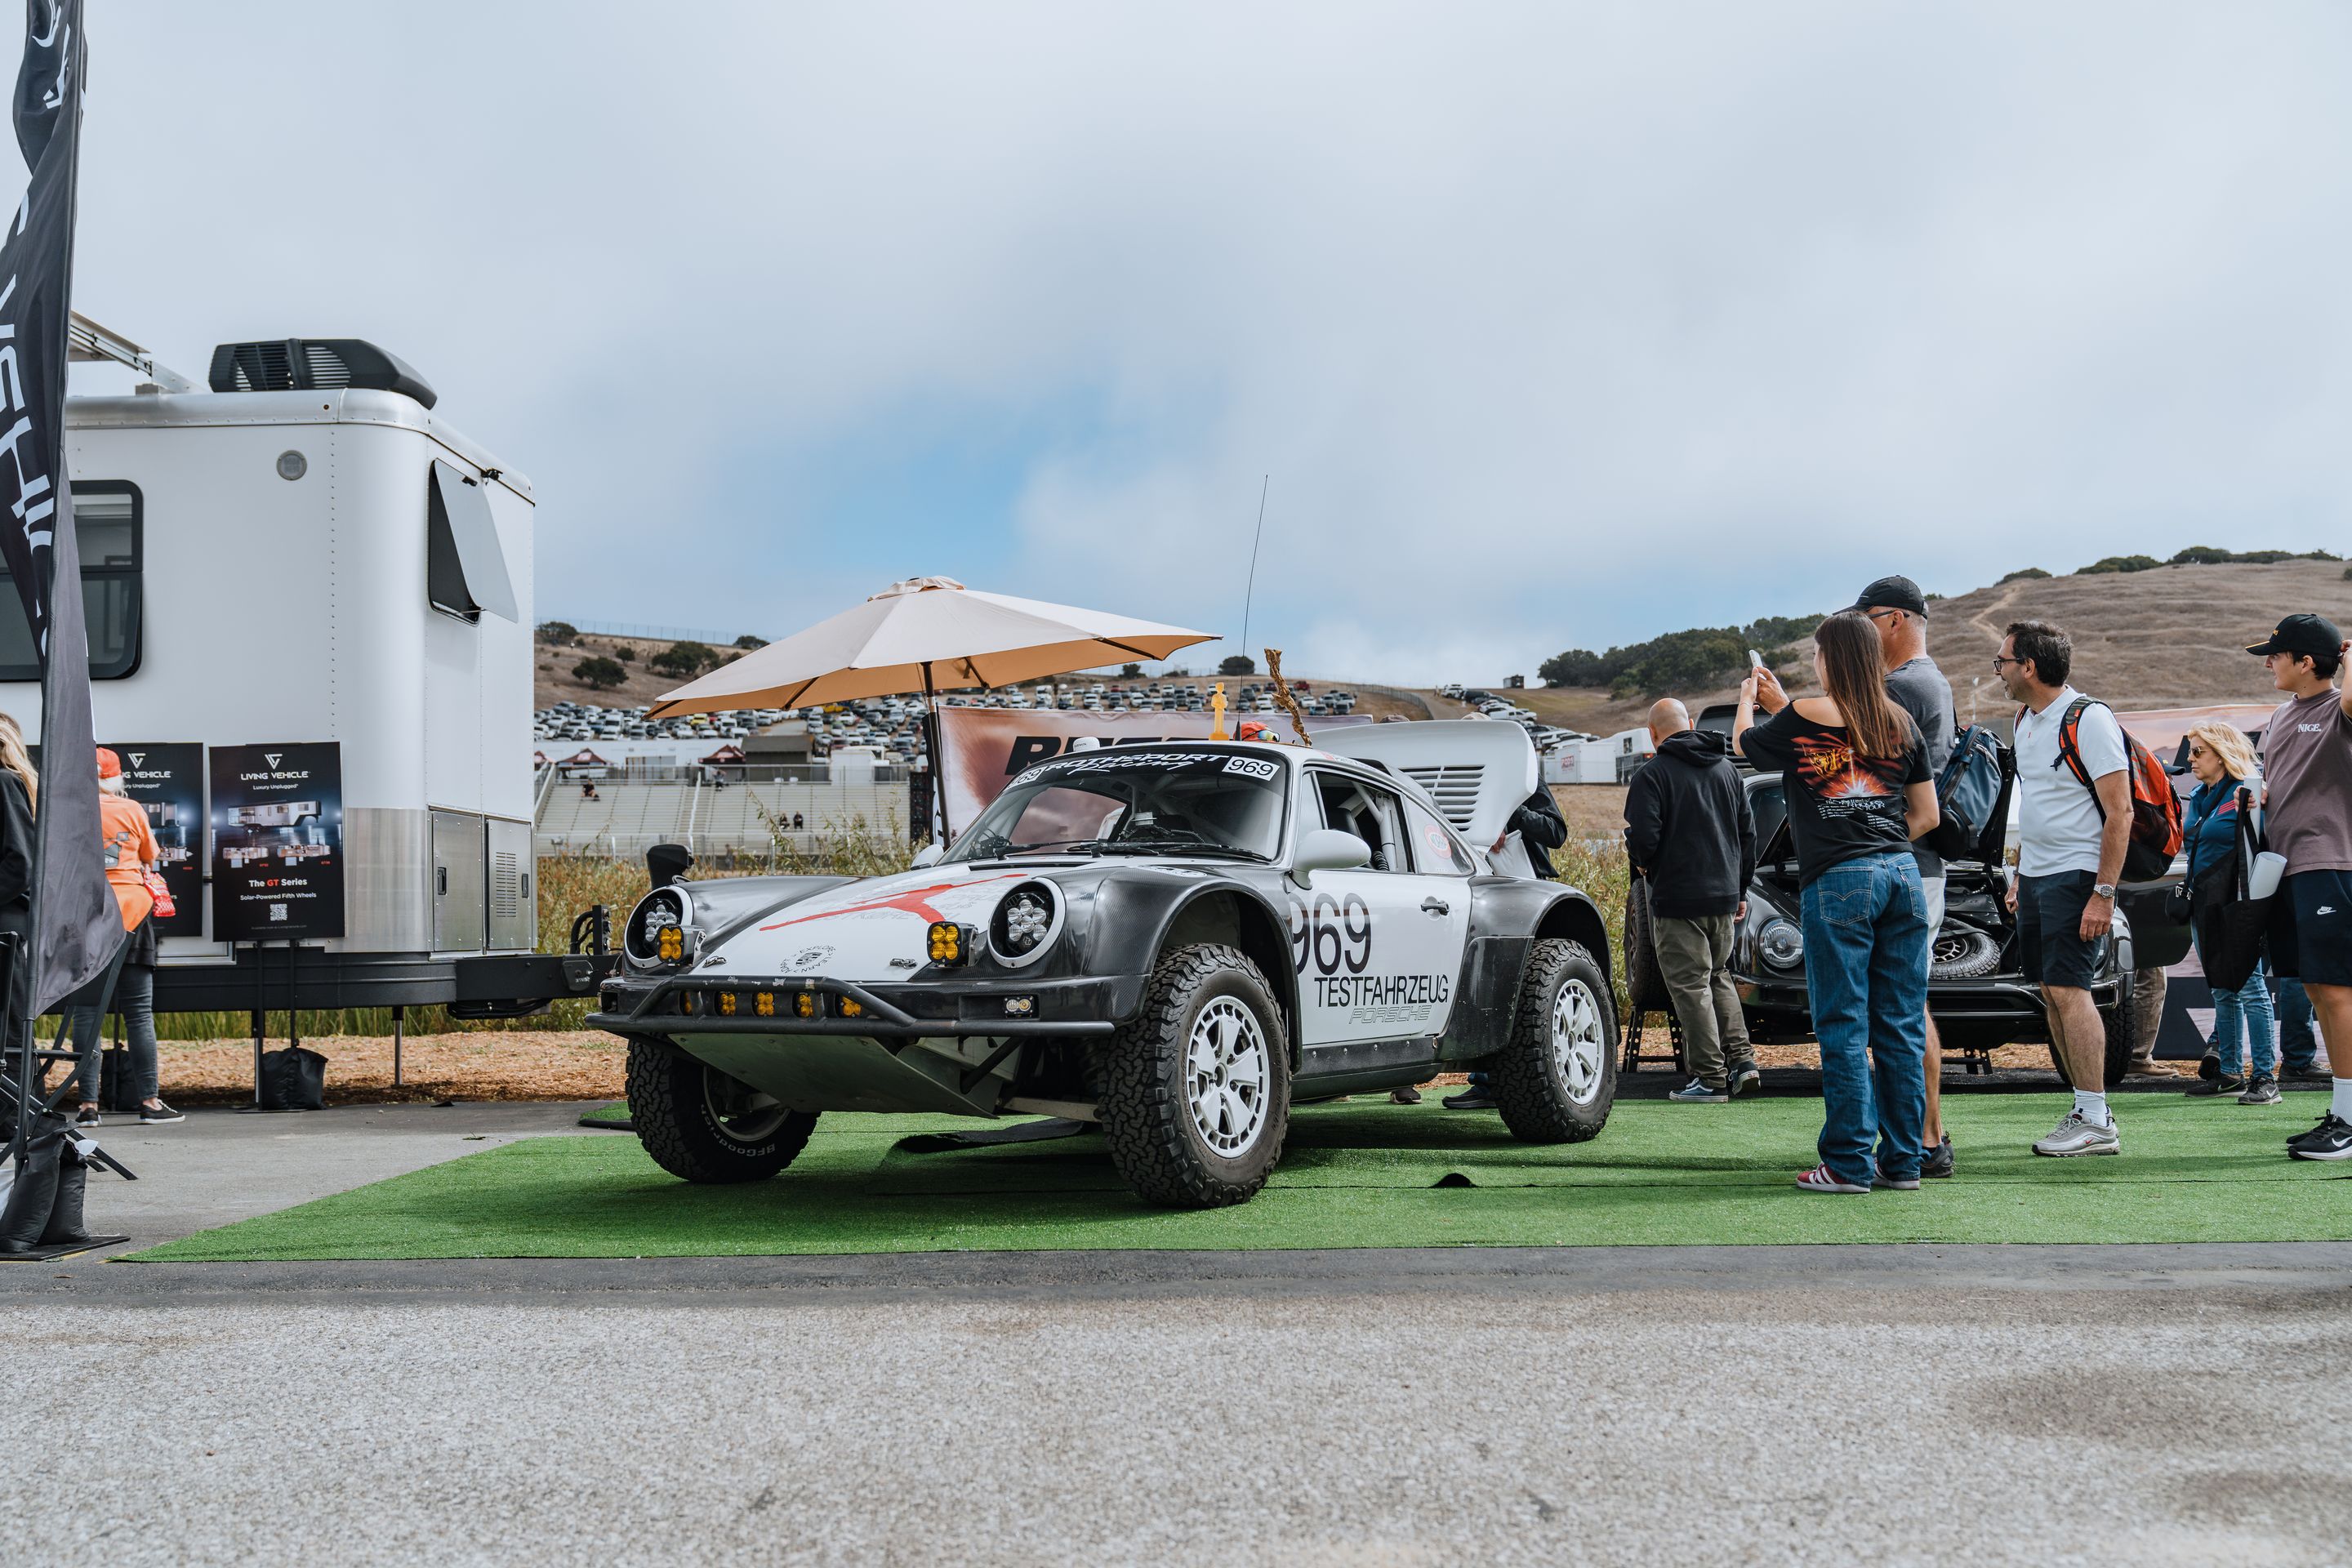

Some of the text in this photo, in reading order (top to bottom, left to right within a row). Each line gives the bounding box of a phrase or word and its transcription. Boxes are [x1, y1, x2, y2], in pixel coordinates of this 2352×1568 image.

[1045, 753, 1229, 772] ROTHSPORT
[1067, 760, 1195, 776] Racing
[1228, 759, 1274, 776] 969
[240, 771, 309, 781] LIVING VEHICLE
[248, 878, 308, 888] The GT Series
[1289, 893, 1372, 975] 969
[1314, 973, 1449, 1008] TESTFAHRZEUG
[1349, 1004, 1432, 1024] PORSCHE
